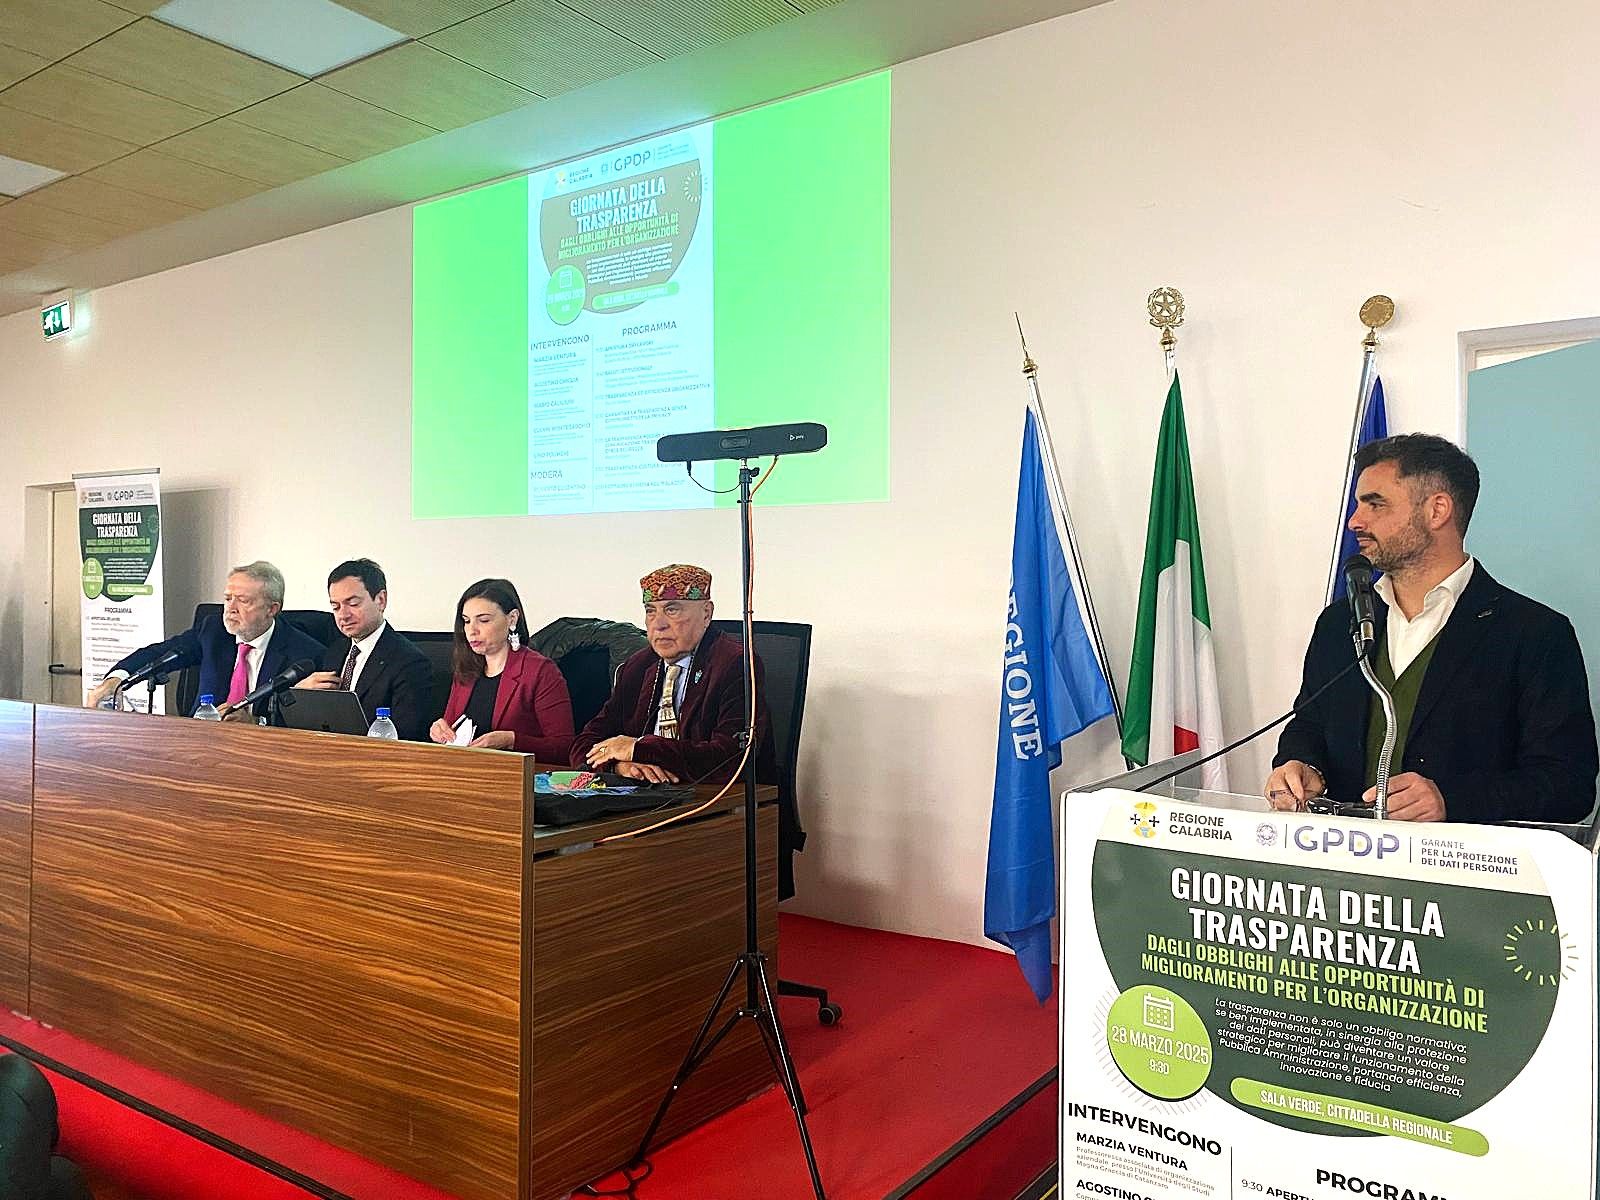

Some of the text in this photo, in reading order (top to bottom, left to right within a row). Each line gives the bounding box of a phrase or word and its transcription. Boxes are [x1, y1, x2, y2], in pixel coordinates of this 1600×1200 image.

[614, 150, 651, 171] GPDP
[570, 176, 666, 216] GIORNATA DELLA
[577, 199, 658, 234] TRASPARENZA
[530, 334, 590, 351] INTERVENGONO
[622, 320, 677, 337] PROGRAMMA
[531, 470, 563, 479] MODERA
[92, 512, 142, 525] GIORNATA DELLA
[97, 525, 138, 538] TRASPARENZA
[1005, 572, 1043, 760] EGIONE
[1169, 812, 1225, 827] REGIONE
[1169, 825, 1233, 841] CALABRIA
[1294, 825, 1400, 860] GPDP
[1421, 838, 1465, 850] GARANTE
[1421, 849, 1518, 866] PER LA PROTEZIONE
[1421, 857, 1518, 875] DEI DATI PERSONALI
[1171, 867, 1445, 938] GIORNATA DELLA
[1188, 907, 1421, 974] TRASPARENZA
[1141, 953, 1268, 995] MIGLIORAMENTO
[1273, 979, 1307, 1002] PER
[1147, 934, 1484, 1009] DAGLI OBBLIGHI ALLE OPPORTUNITÀ DI
[1215, 997, 1226, 1007] La
[1228, 1000, 1287, 1019] trasparenza
[1288, 1014, 1308, 1023] non
[1312, 1017, 1318, 1025] è
[1321, 1018, 1343, 1029] solo
[1345, 1022, 1359, 1031] un
[1362, 1025, 1404, 1041] obbligo
[1215, 1009, 1467, 1064] se ben implementata, in sinergia alla protezione
[1111, 1025, 1210, 1065] 28 MARZO 2025
[1217, 1029, 1465, 1087] strategico per migliorare il funzionamento della
[1229, 1021, 1449, 1072] dei dati personali, può diventare un valore
[1149, 1059, 1170, 1075] 9:30
[1219, 1038, 1462, 1099] Pubblica Amministrazione, portando efficienza,
[1280, 1061, 1392, 1092] innovazione e fiducia
[1068, 1102, 1222, 1156] INTERVENGONO
[1260, 1089, 1453, 1145] SALA VERDE, CITTADELLA REGIONALE
[1076, 1132, 1188, 1171] MARZIA VENTURA
[1076, 1179, 1142, 1200] AGOSTINO
[1241, 1179, 1314, 1200] 9:30 APERT
[1316, 1168, 1447, 1200] PROGRA
